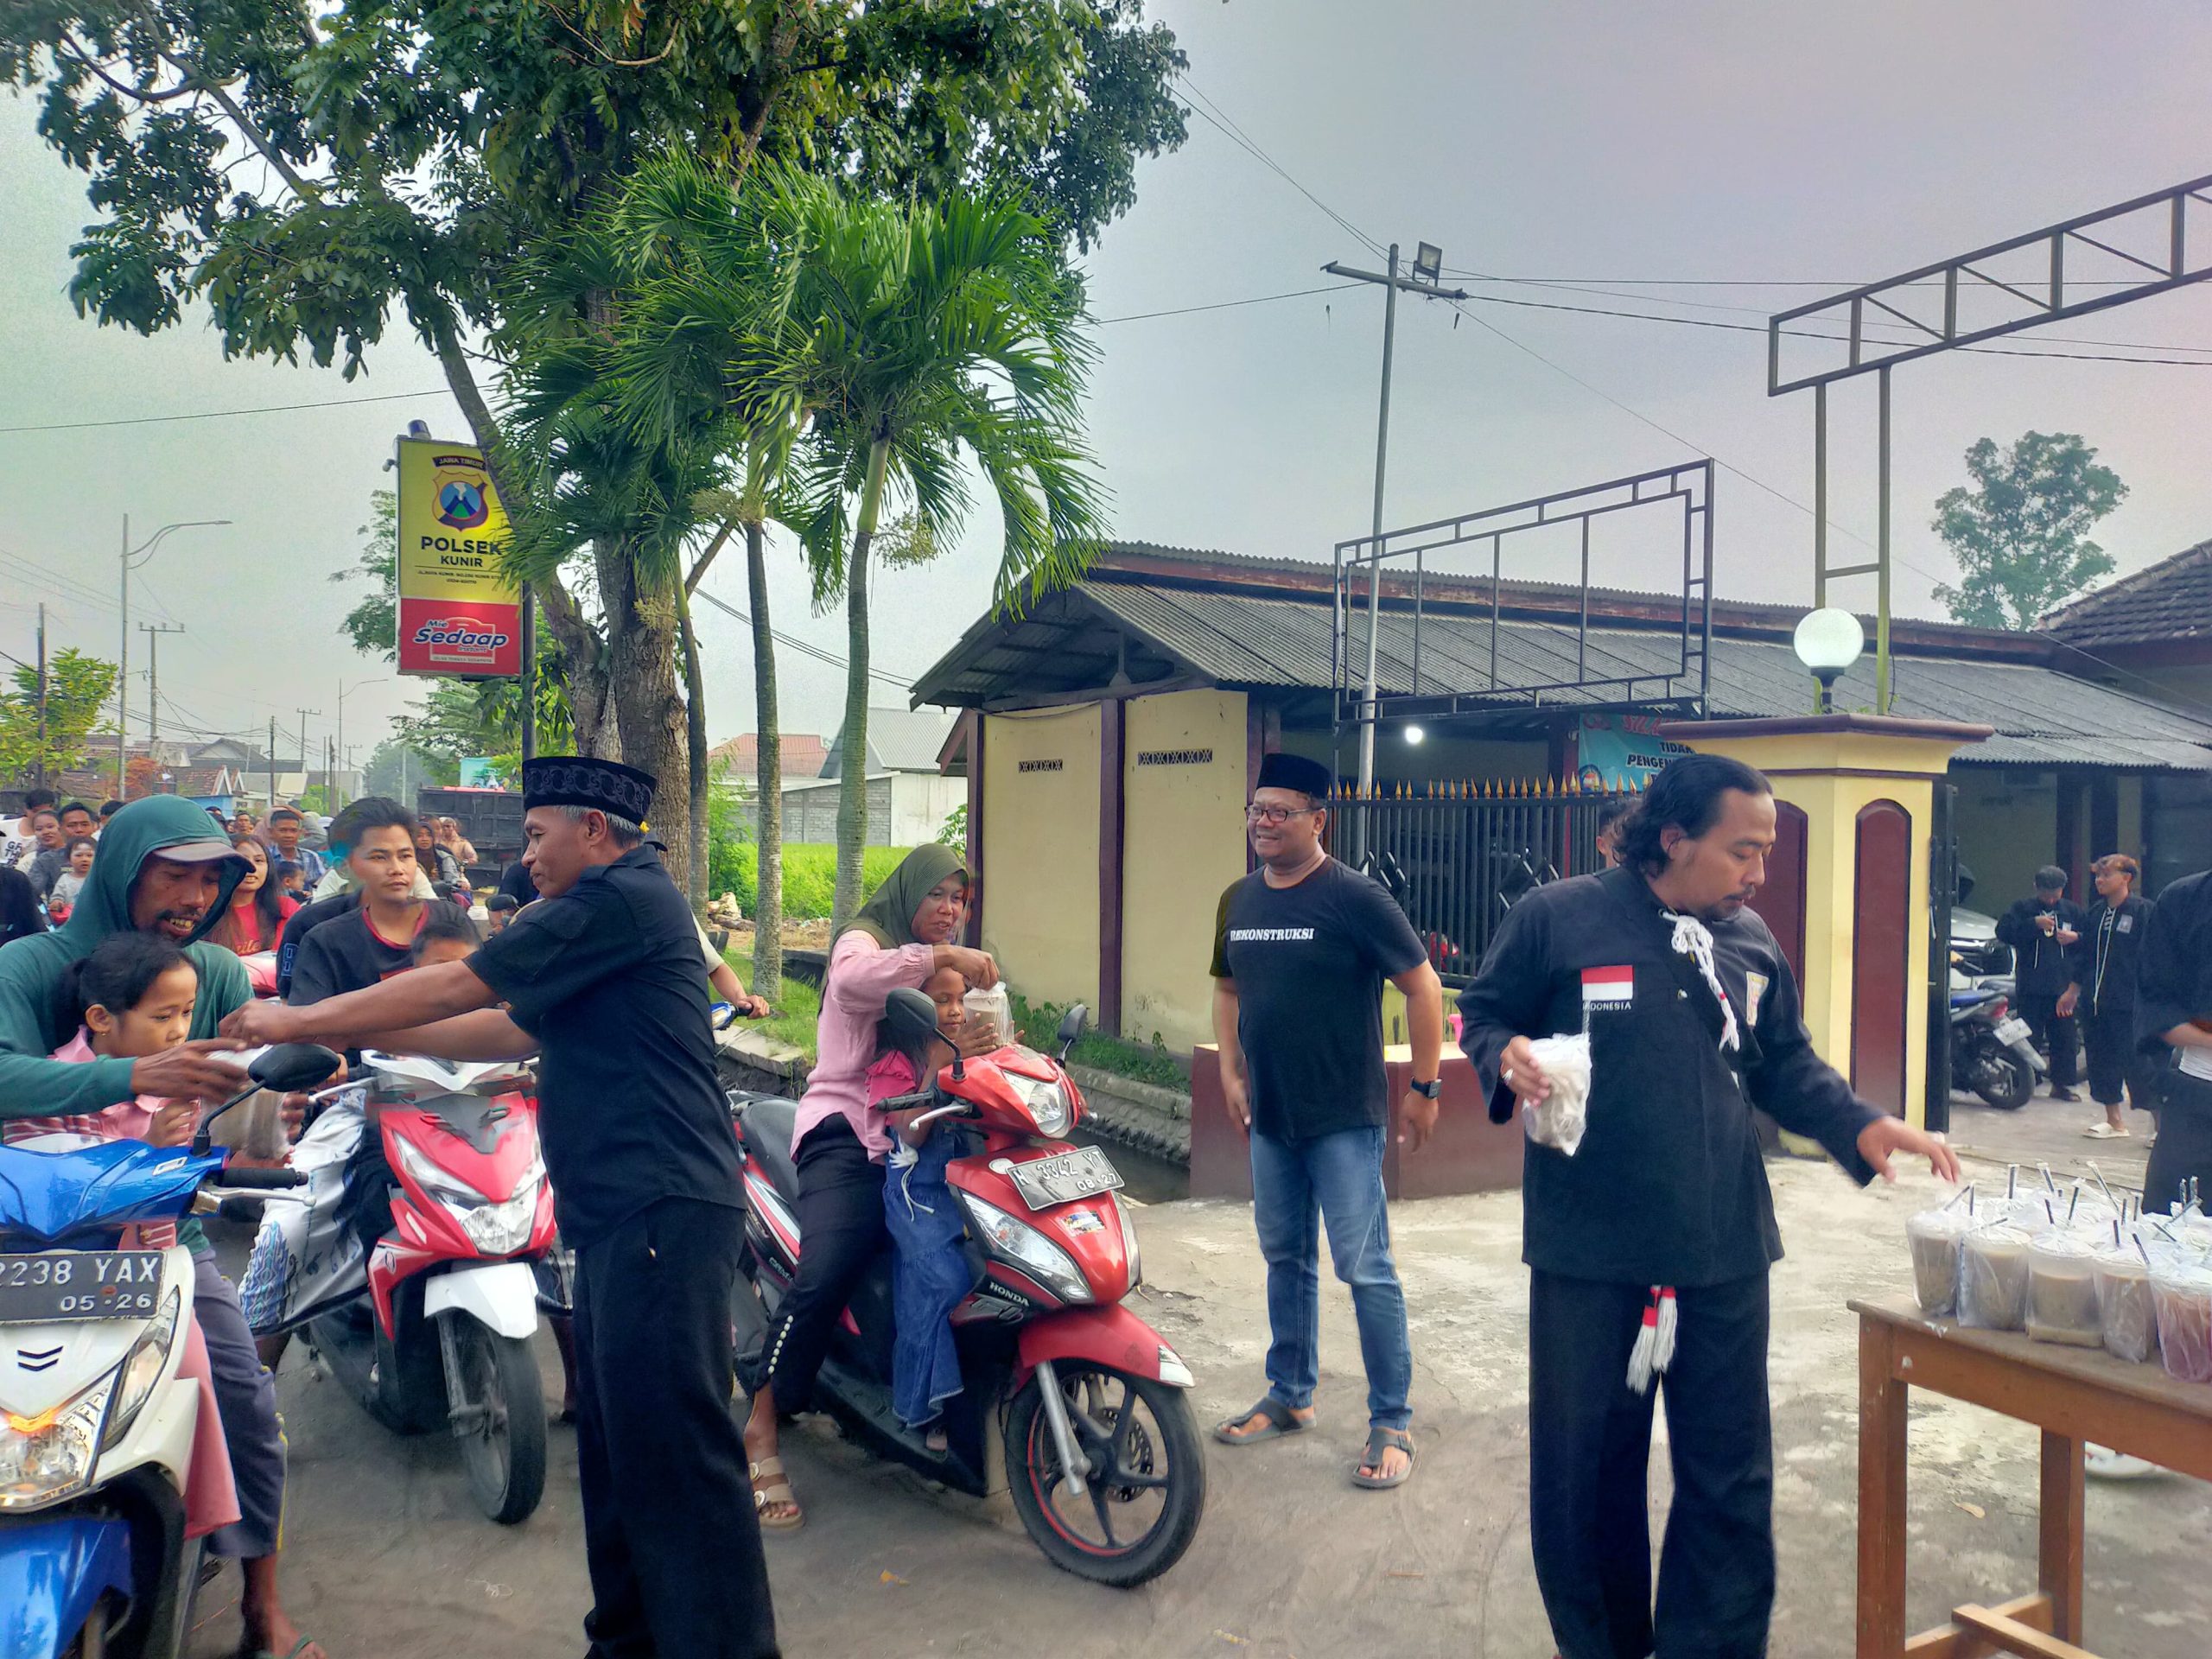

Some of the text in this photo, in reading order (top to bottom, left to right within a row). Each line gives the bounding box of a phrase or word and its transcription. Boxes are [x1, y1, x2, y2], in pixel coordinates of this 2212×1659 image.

[421, 536, 504, 556] POLSEK
[441, 555, 483, 568] KUNIR
[427, 620, 448, 628] Mie
[414, 628, 508, 649] Sedaap
[1230, 928, 1315, 941] REKONSTRUKSI
[1036, 1159, 1078, 1181] 3342
[1082, 1150, 1105, 1169] YT
[94, 1257, 159, 1283] YAX
[988, 1281, 1030, 1307] HONDA
